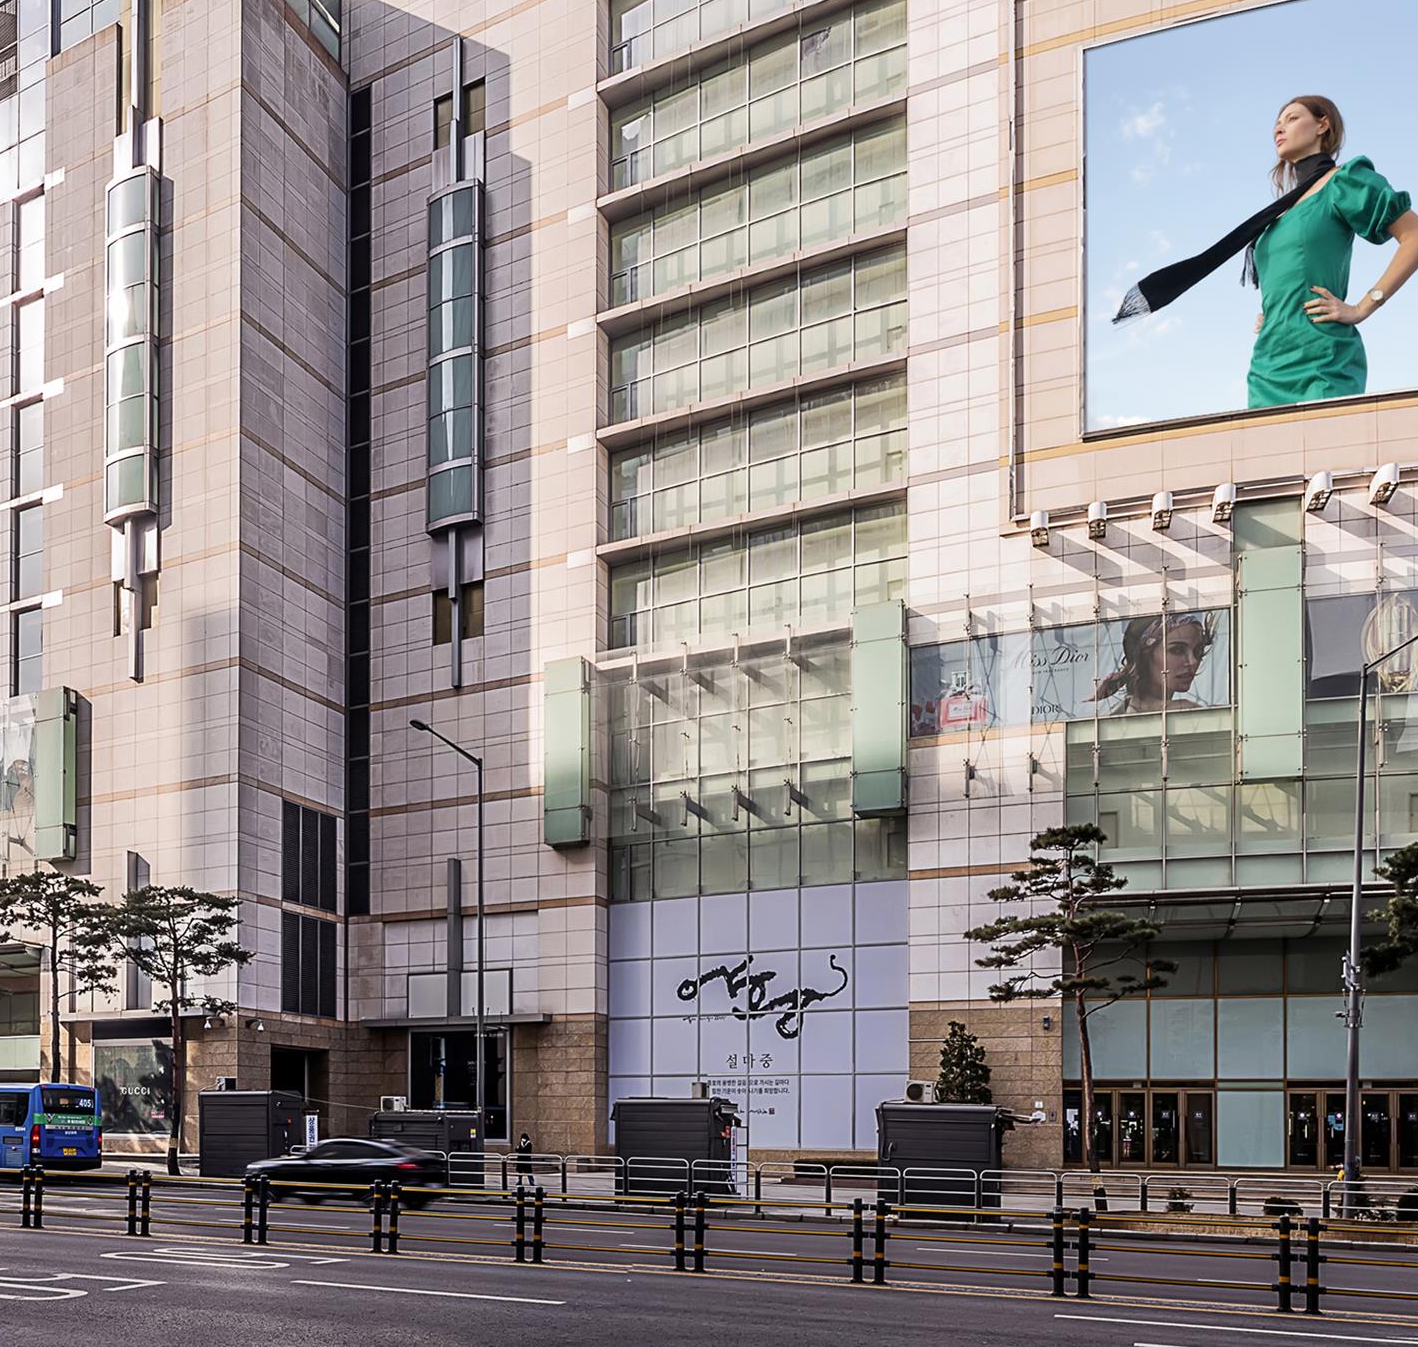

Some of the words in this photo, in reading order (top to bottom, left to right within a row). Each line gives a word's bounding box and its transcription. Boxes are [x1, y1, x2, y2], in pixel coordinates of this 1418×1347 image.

[1049, 646, 1089, 666] Dior
[1031, 704, 1060, 715] DIOR
[121, 1086, 151, 1096] GUCCI
[79, 1099, 92, 1108] 405
